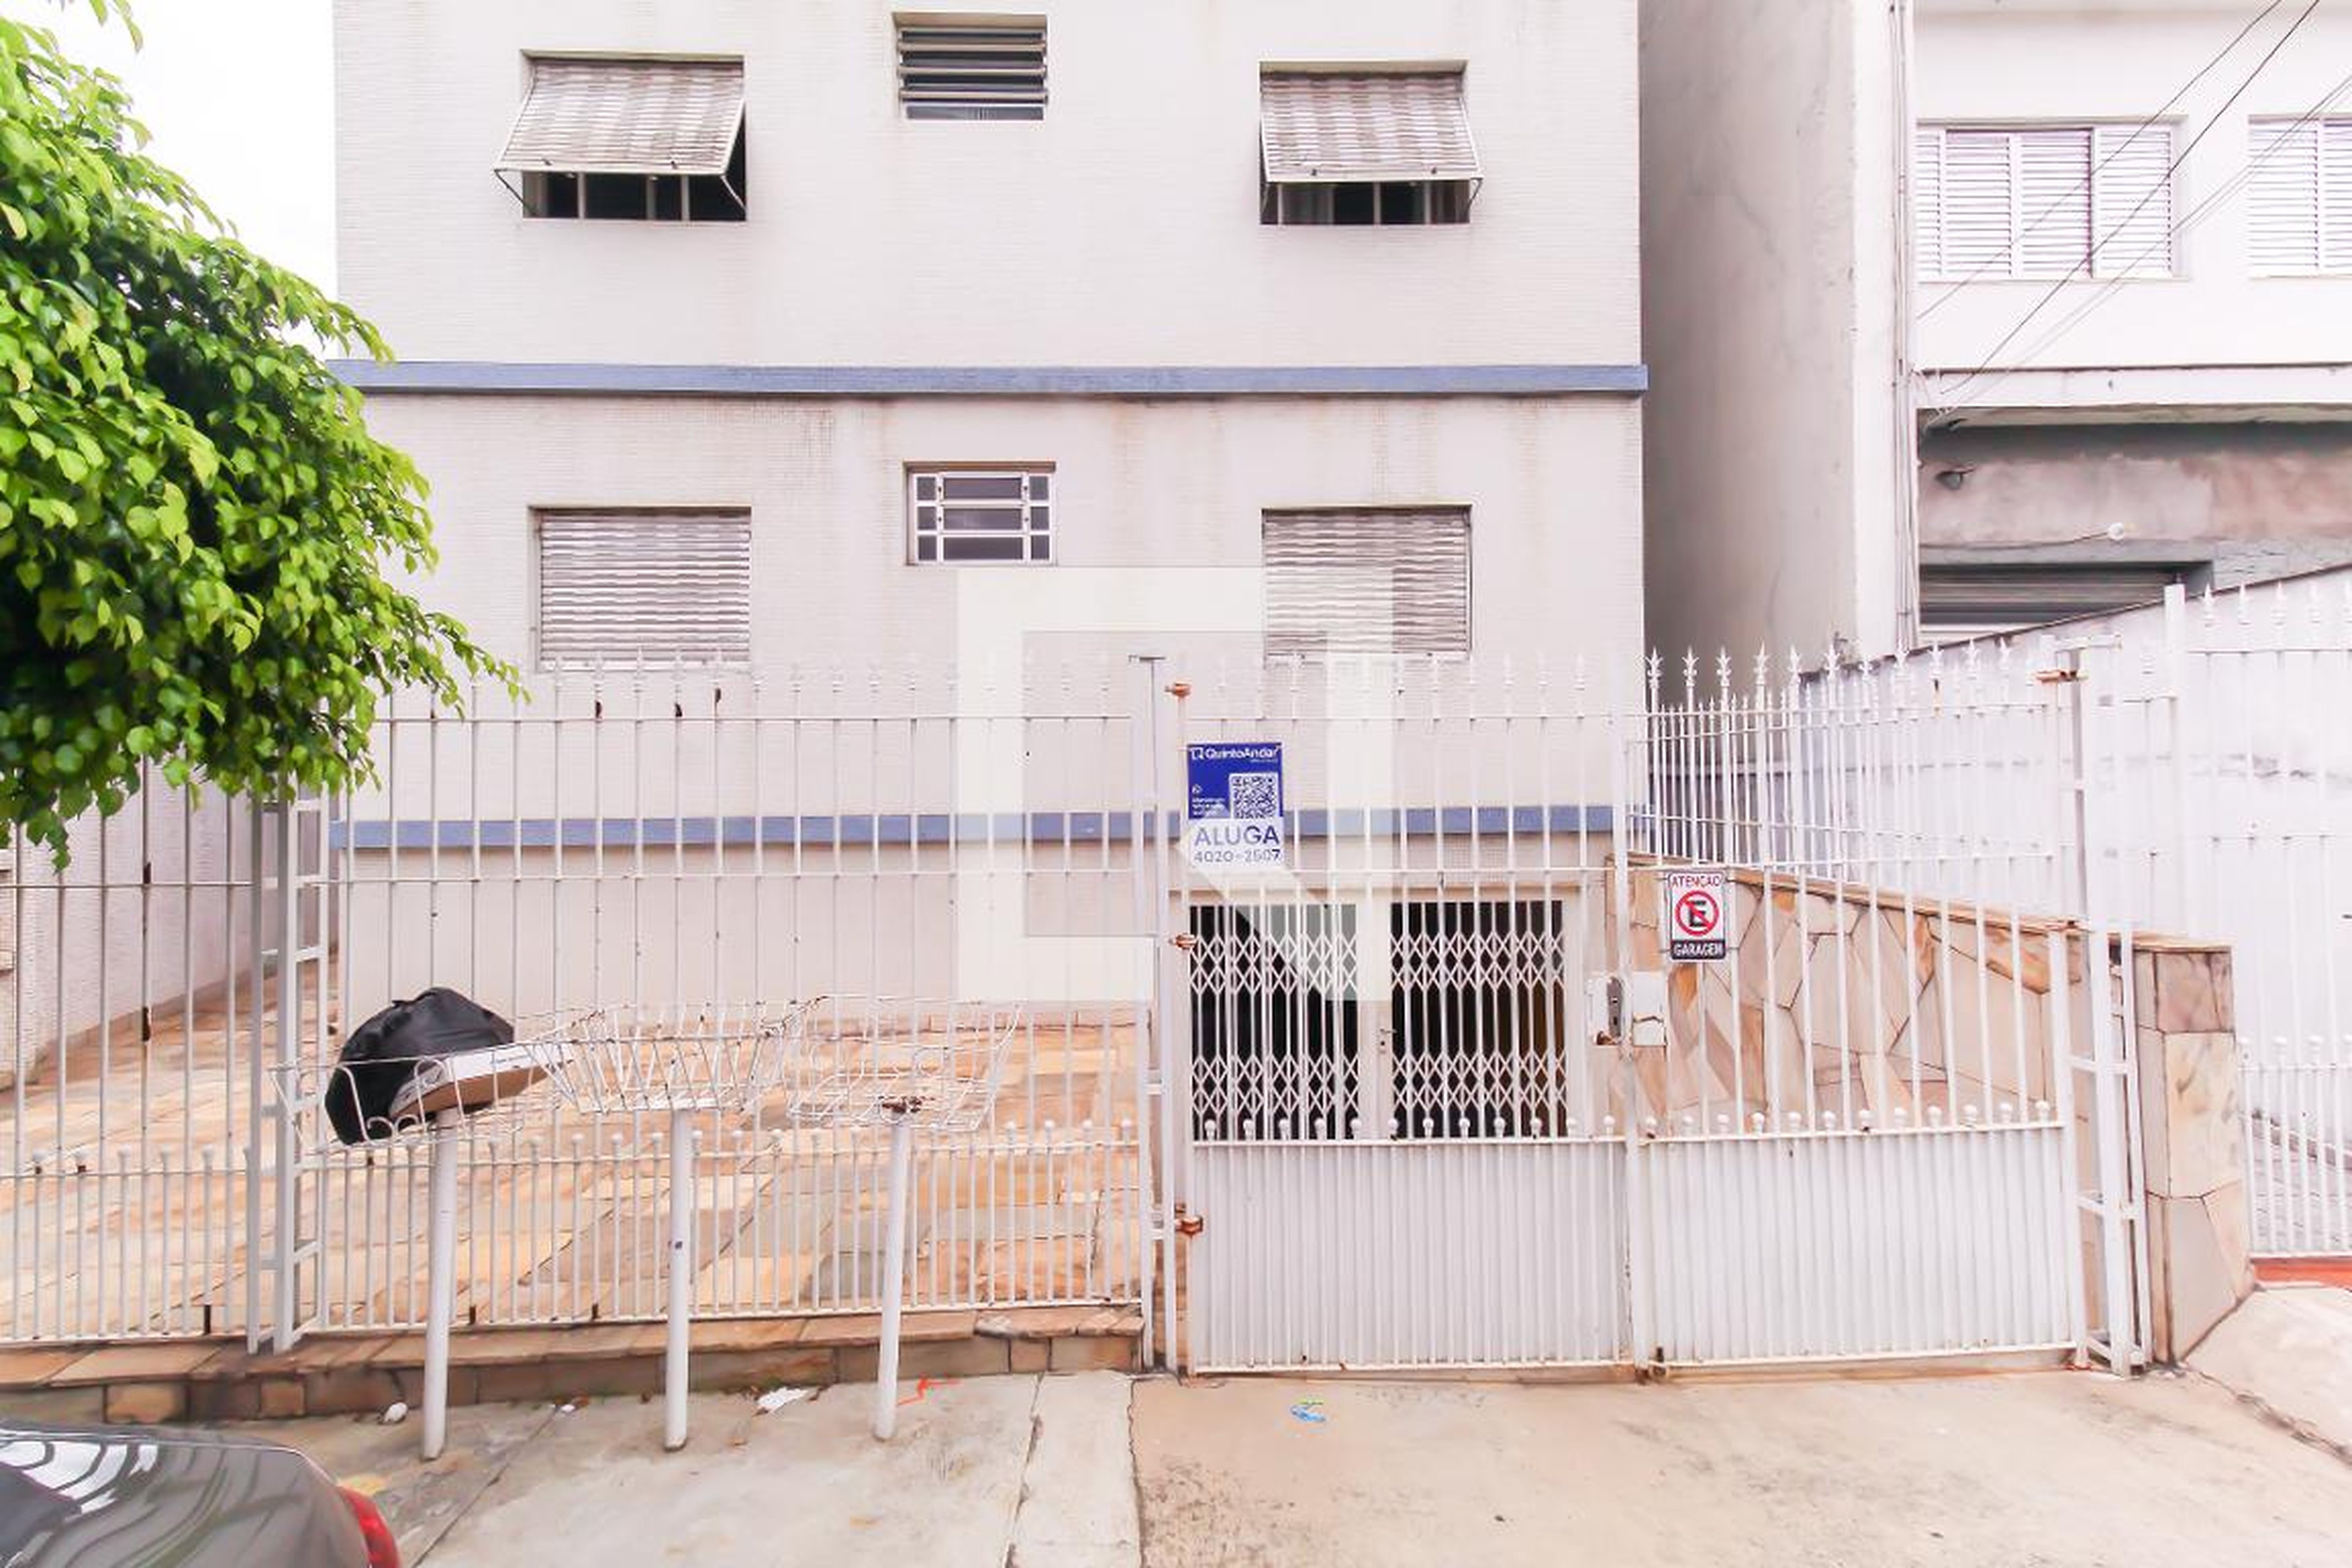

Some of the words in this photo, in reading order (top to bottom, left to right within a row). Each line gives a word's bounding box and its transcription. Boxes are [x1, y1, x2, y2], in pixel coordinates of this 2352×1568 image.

[1195, 825, 1280, 845] ALUGA
[1194, 848, 1281, 862] 4020-2507
[1673, 943, 1723, 957] GARAGEM
